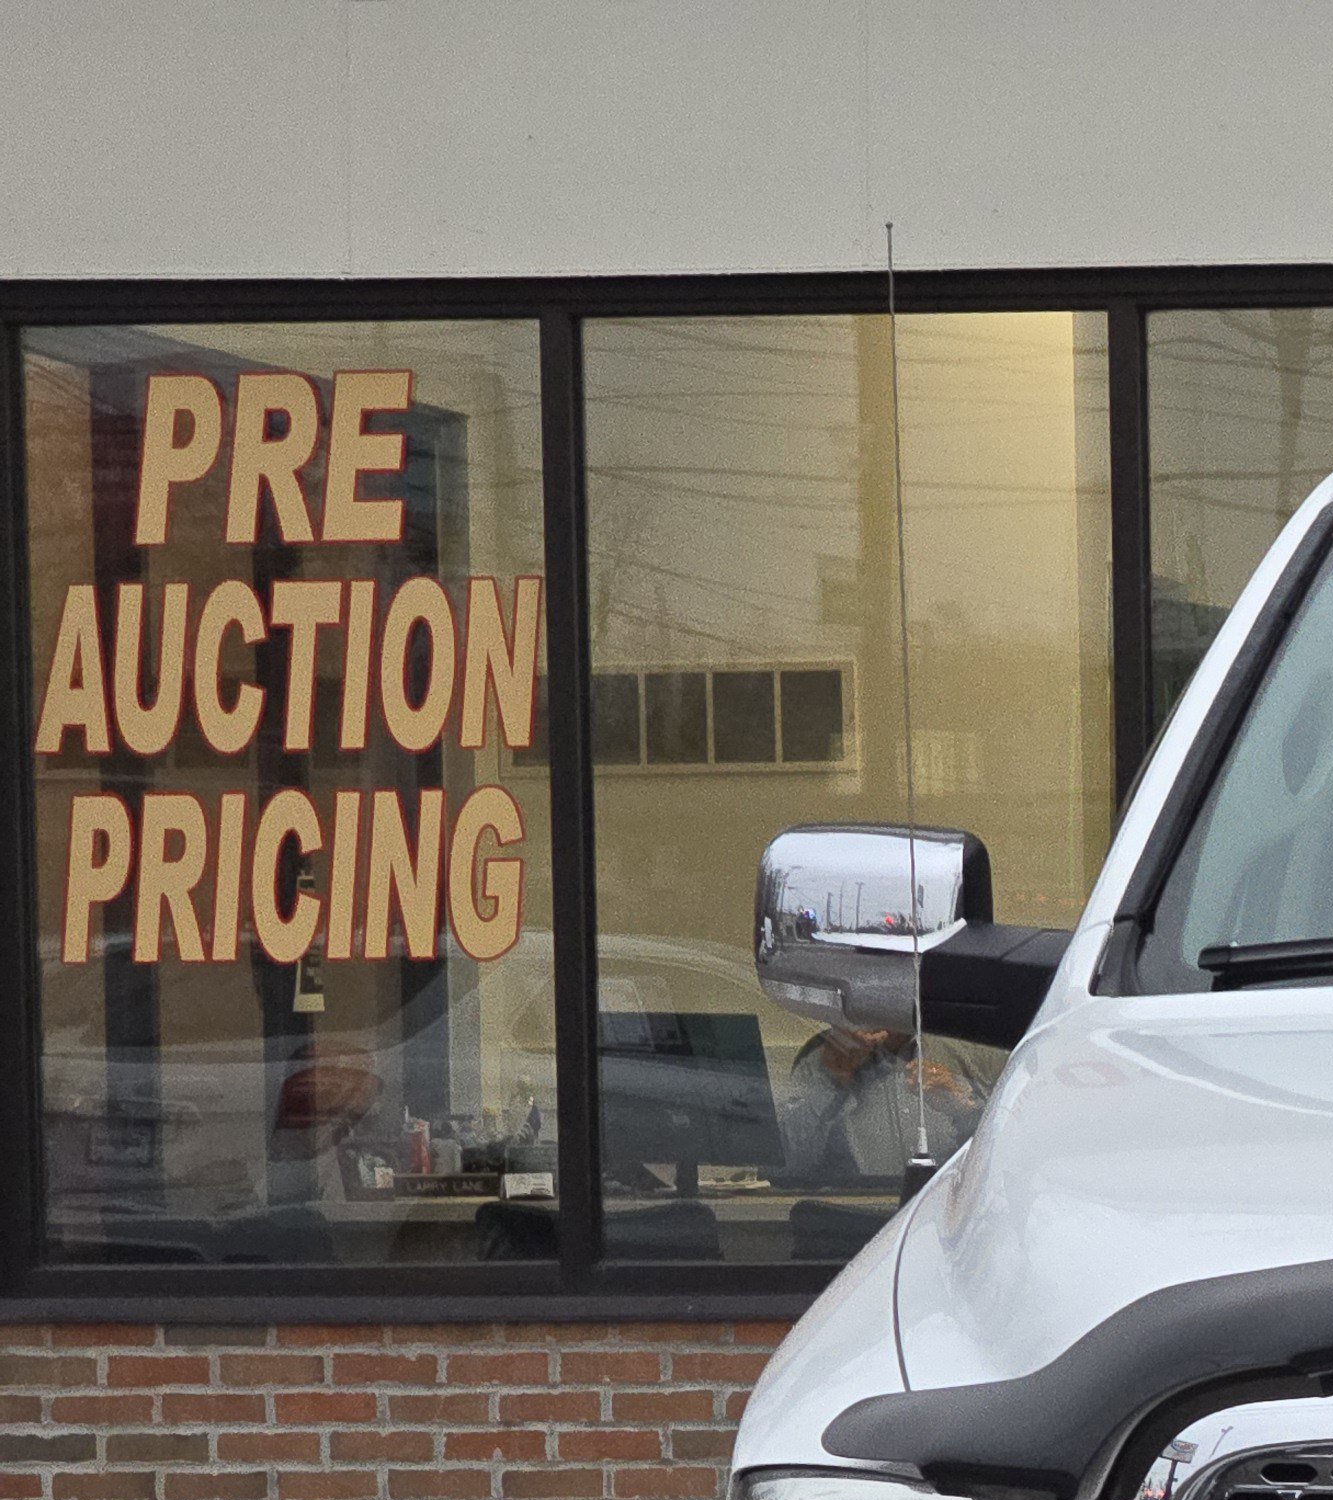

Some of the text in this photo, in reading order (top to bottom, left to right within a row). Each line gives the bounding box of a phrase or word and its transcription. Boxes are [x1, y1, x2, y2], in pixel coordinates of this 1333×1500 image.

[134, 369, 412, 546] PRE
[35, 576, 542, 755] AUCTION
[61, 784, 525, 963] PRICING
